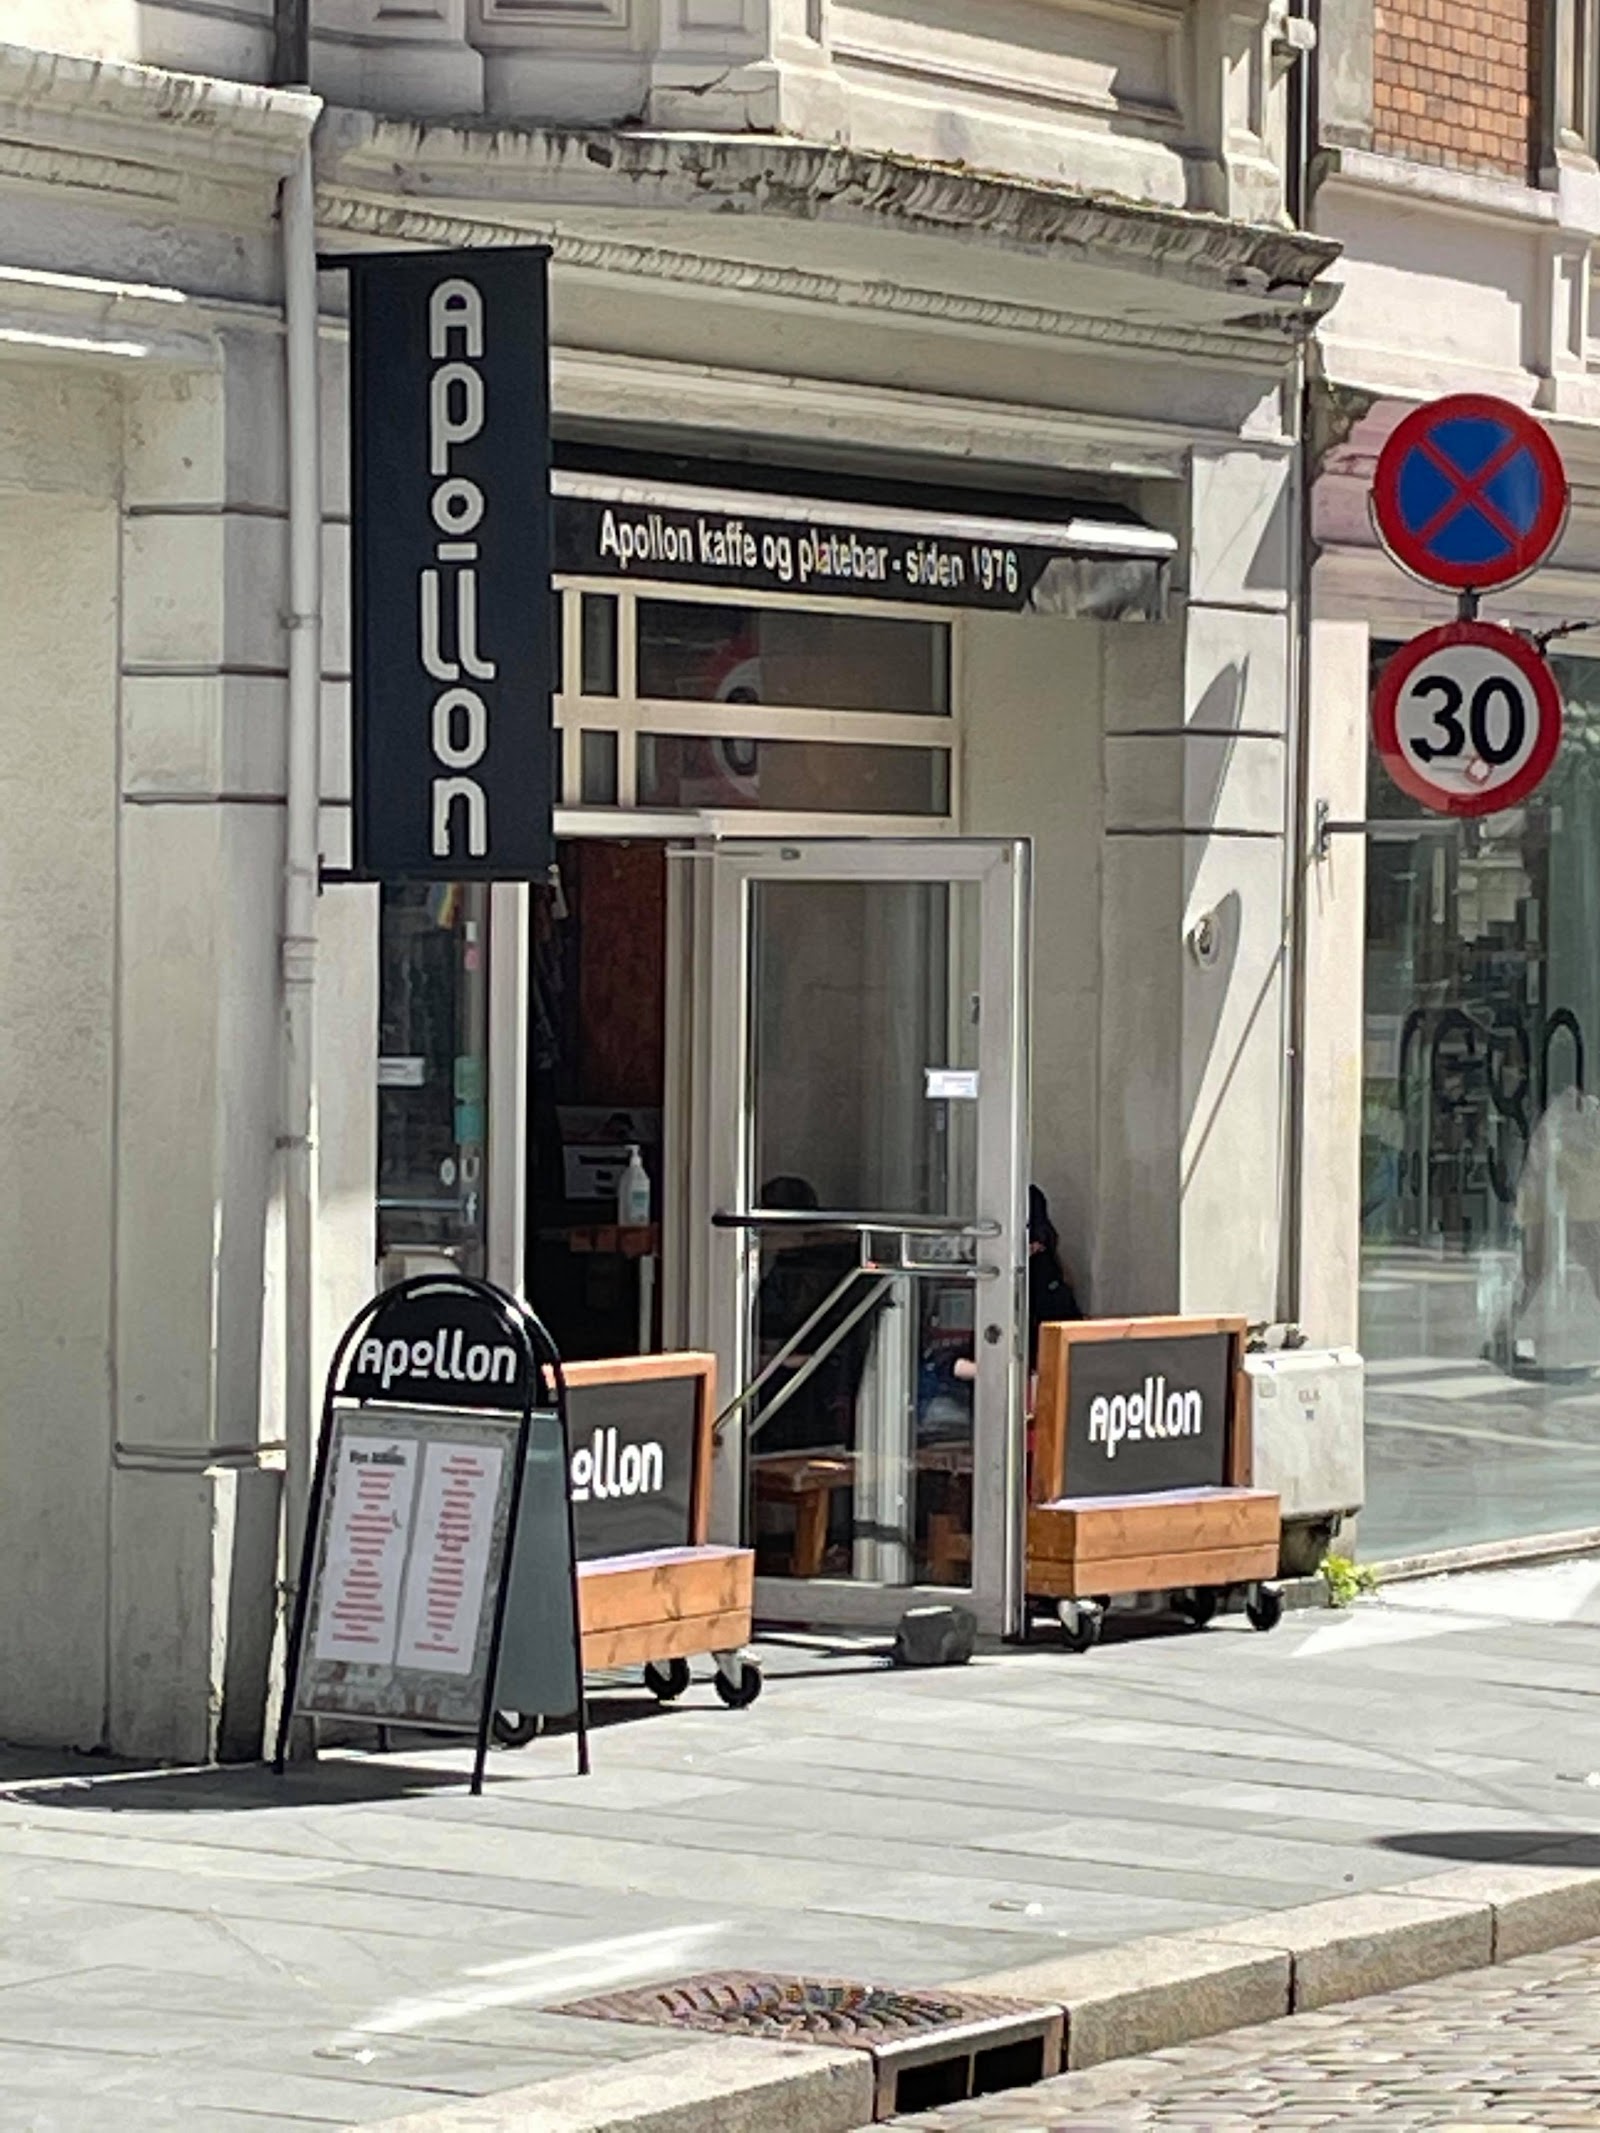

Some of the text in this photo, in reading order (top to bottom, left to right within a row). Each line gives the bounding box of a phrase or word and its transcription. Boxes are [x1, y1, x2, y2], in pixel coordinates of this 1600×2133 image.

[421, 278, 496, 856] Apollon
[600, 508, 694, 570] Apollon
[698, 518, 758, 568] kaffe
[762, 533, 794, 583] og
[797, 527, 889, 584] platebar
[906, 540, 965, 588] siden
[970, 545, 1019, 594] 1976
[1409, 674, 1527, 766] 30
[357, 1328, 518, 1389] Apollon
[1088, 1375, 1204, 1459] Apollon
[570, 1426, 664, 1502] ollon
